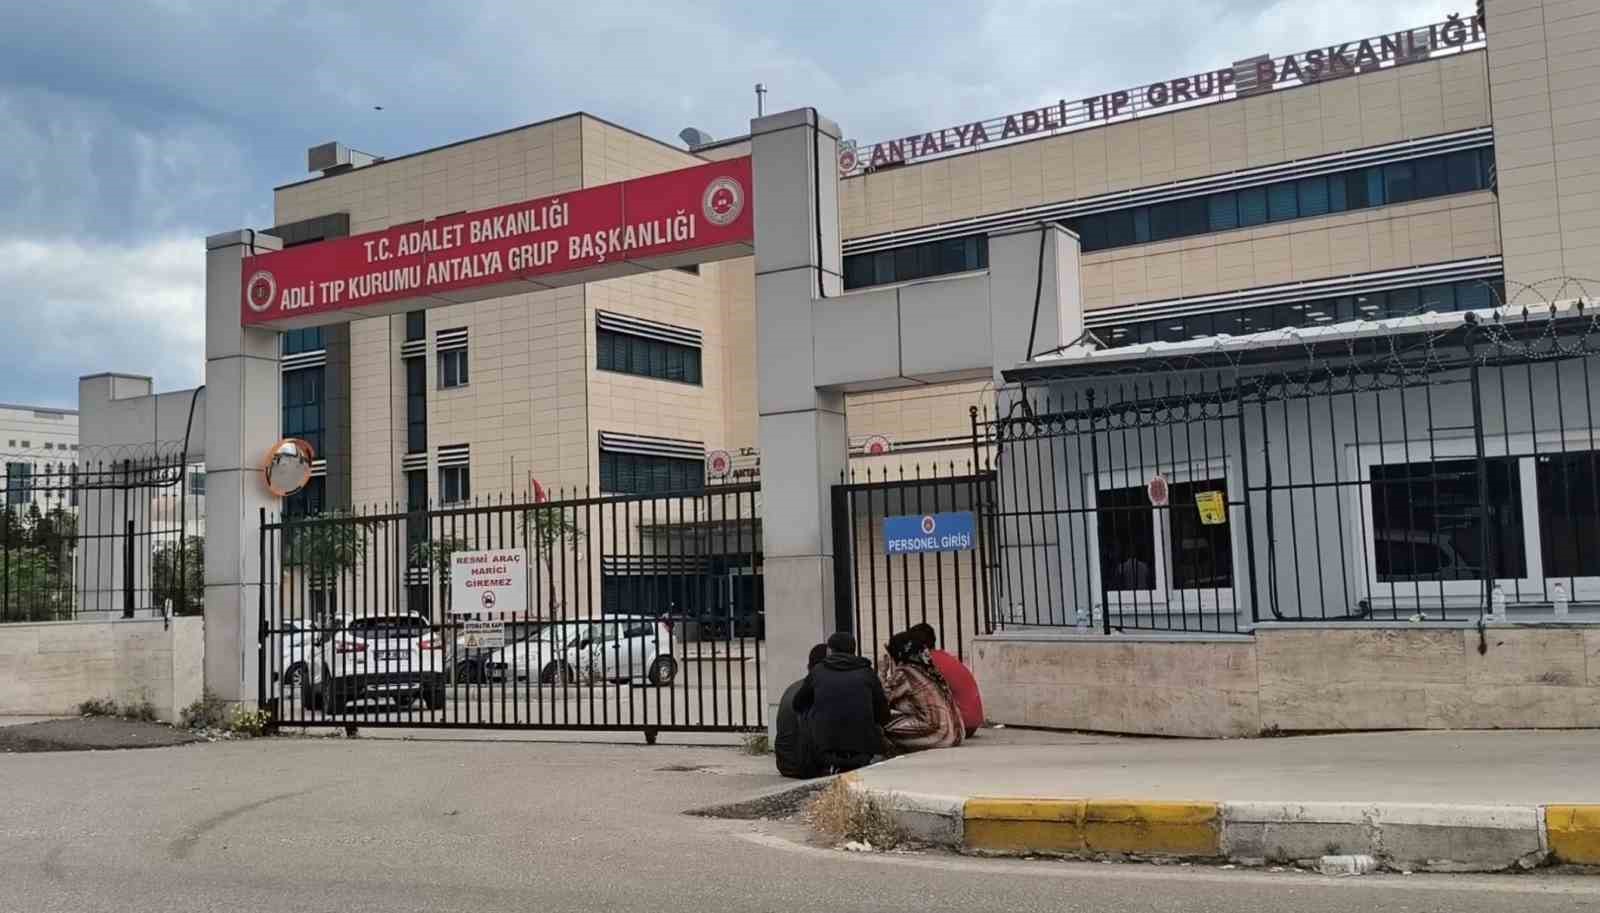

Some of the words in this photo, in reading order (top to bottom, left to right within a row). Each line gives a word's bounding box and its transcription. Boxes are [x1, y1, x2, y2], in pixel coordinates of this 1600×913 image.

[869, 122, 989, 168] ANTALYA
[1001, 99, 1067, 140] ADLİ
[1082, 90, 1129, 121] TIP
[1147, 68, 1235, 107] GRUP
[280, 280, 315, 311] ADLİ
[320, 280, 345, 304] TIP
[349, 266, 421, 300] KURUMU
[426, 251, 503, 286] ANTALYA
[508, 240, 559, 271] GRUP
[568, 209, 696, 263] BAŞKANLIĞI
[364, 238, 394, 263] T.C.
[398, 224, 465, 257] ADALET
[470, 198, 569, 244] BAKANLIĞI
[492, 554, 521, 564] ARAÇ
[888, 536, 940, 552] PERSONEL
[941, 531, 971, 549] GİRİŞİ
